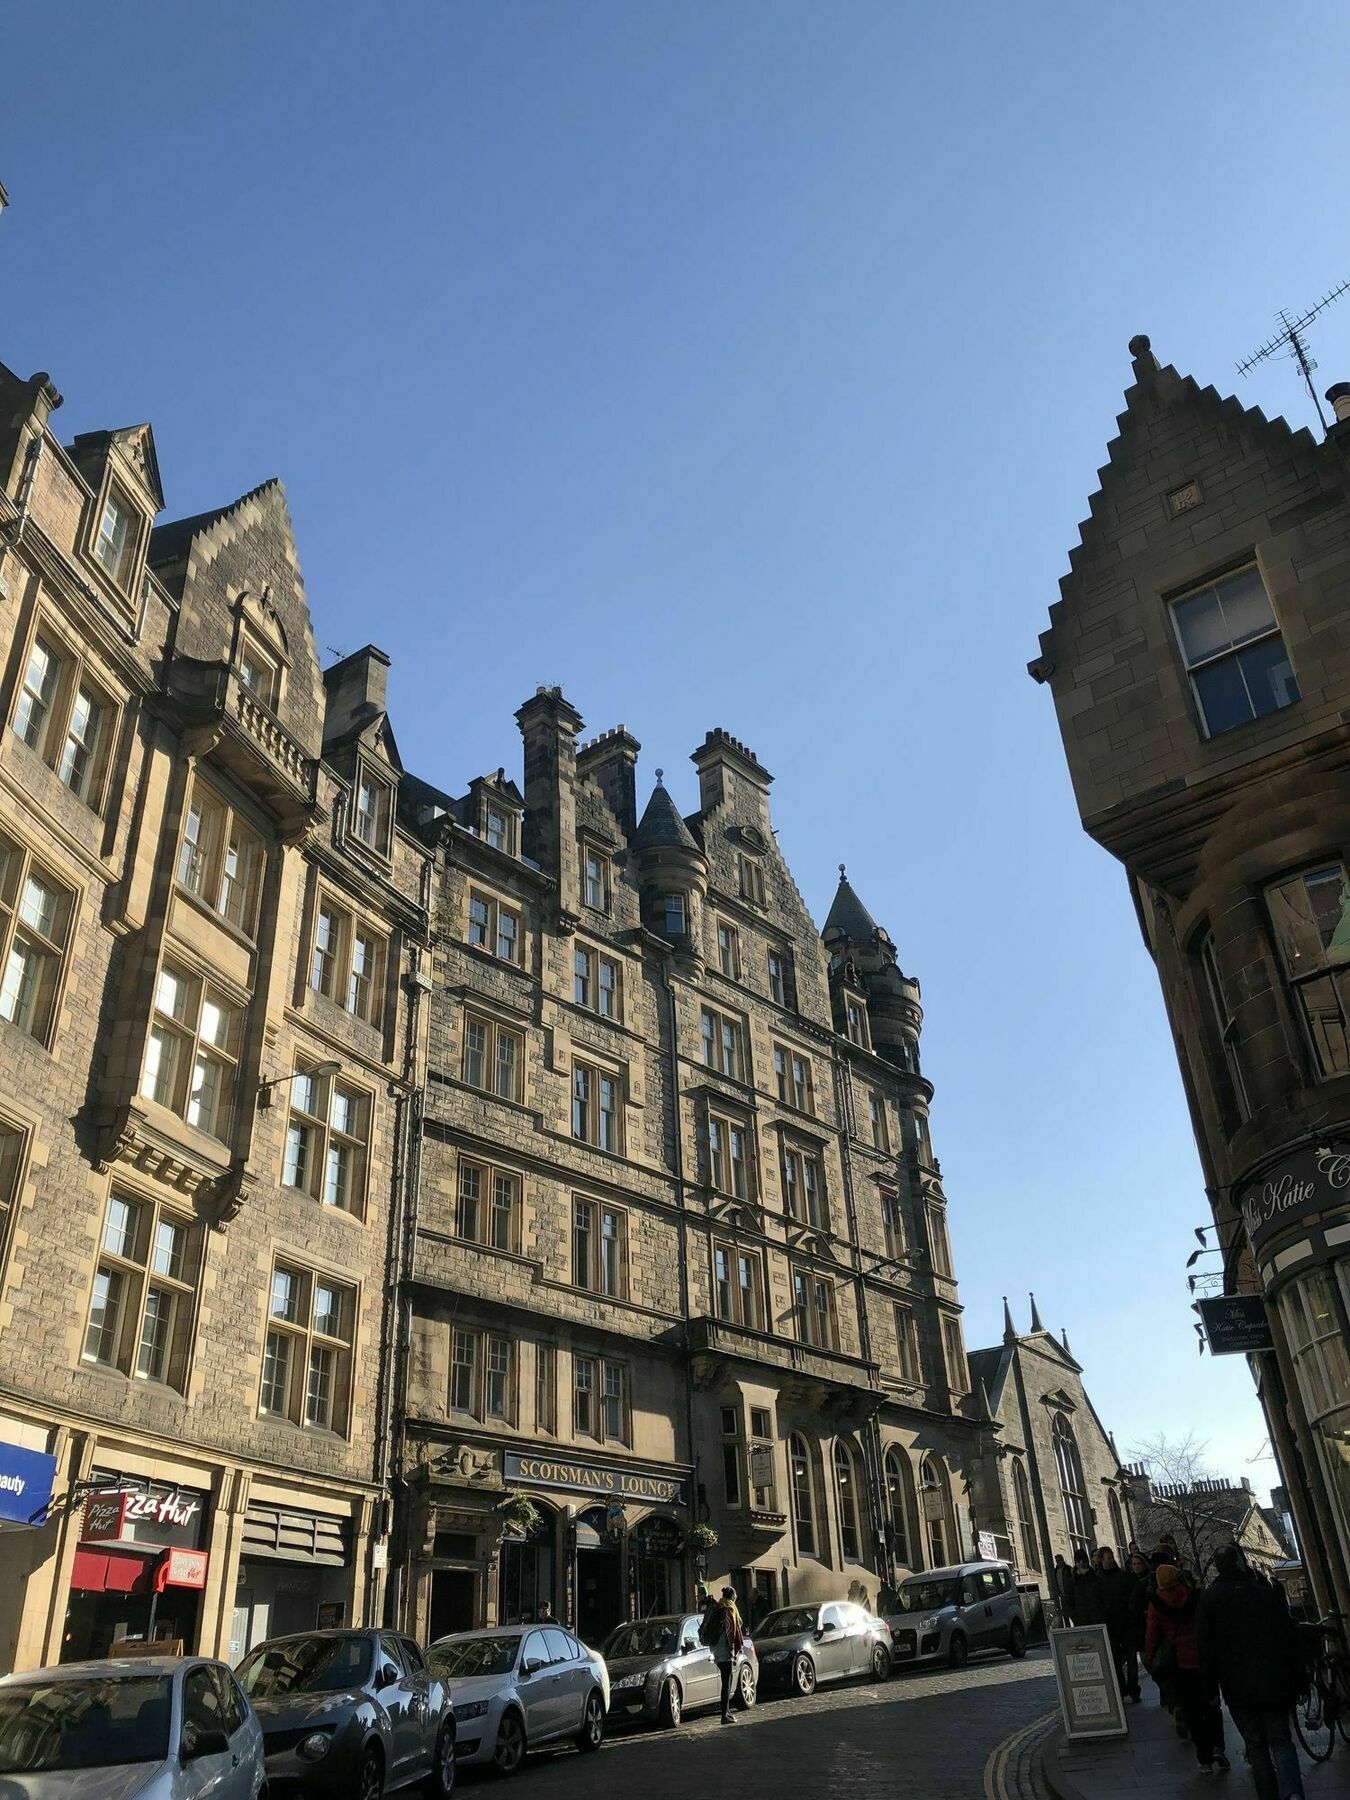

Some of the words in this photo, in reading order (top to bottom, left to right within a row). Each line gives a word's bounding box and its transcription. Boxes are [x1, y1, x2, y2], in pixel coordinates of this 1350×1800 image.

[1263, 1174, 1315, 1220] Katie
[0, 1473, 25, 1496] auty
[520, 1459, 614, 1489] SCOTSMAN'S
[621, 1476, 675, 1498] LOUNGE
[88, 1503, 120, 1519] Pizza
[157, 1492, 200, 1526] Hut
[89, 1518, 115, 1531] Hut
